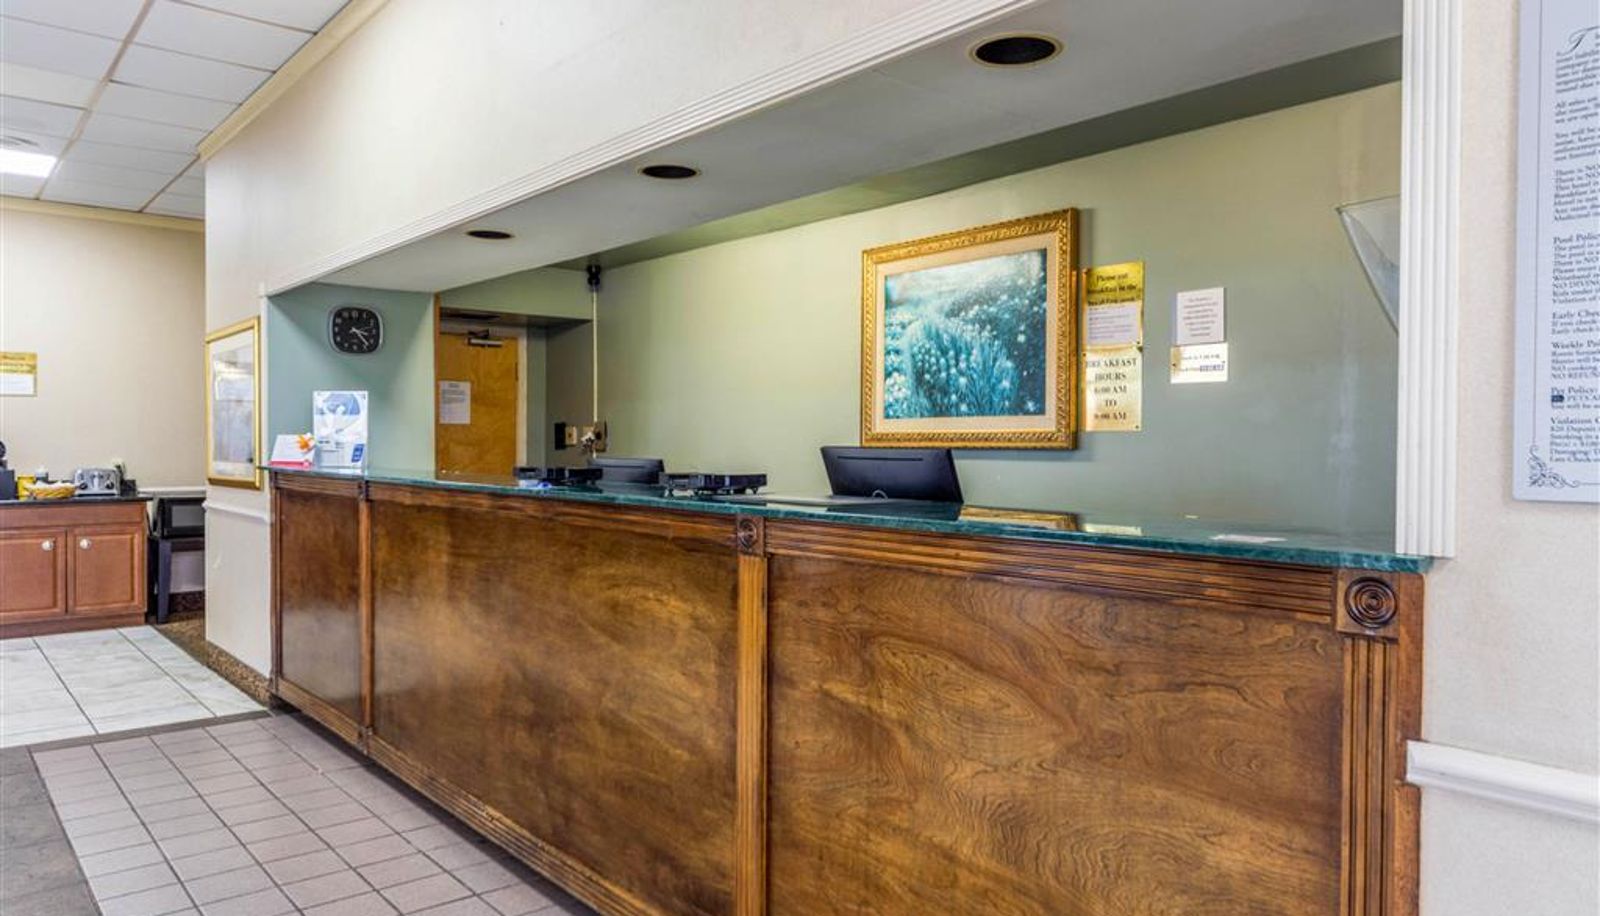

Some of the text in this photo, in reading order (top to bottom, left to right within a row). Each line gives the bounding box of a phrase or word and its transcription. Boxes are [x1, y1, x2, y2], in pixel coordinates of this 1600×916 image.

[1553, 234, 1573, 244] Pool
[1095, 372, 1127, 382] HOURS
[1113, 385, 1127, 394] AM
[1105, 399, 1117, 407] TO
[1113, 411, 1127, 420] AM
